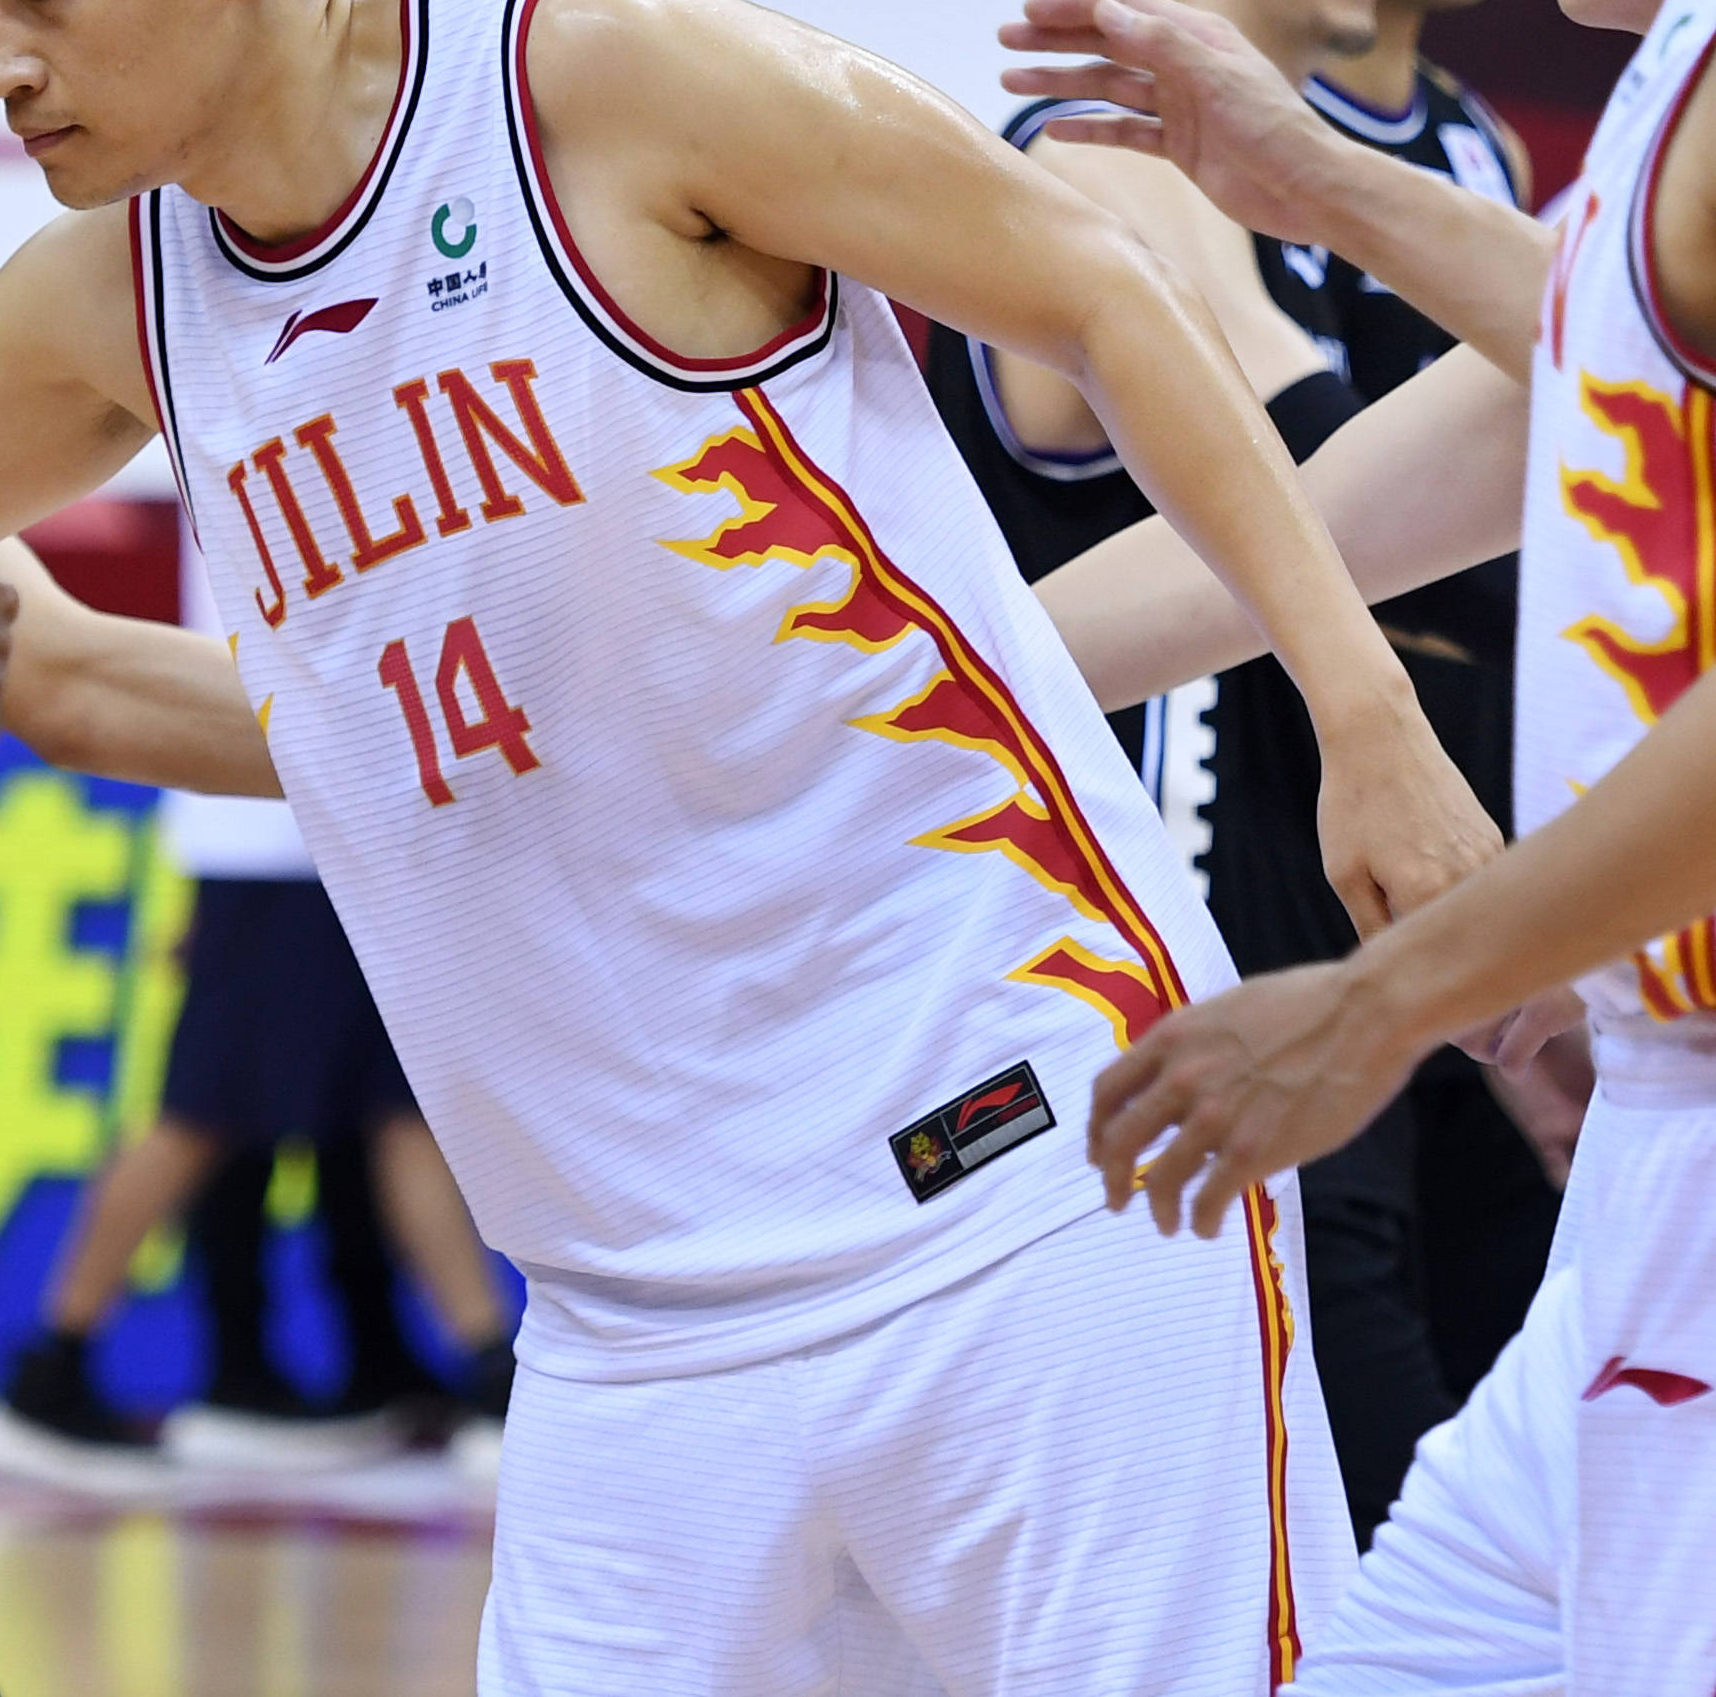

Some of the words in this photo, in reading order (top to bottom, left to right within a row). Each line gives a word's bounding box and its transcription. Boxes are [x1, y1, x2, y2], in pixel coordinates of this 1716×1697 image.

[431, 292, 469, 312] CHINA
[227, 358, 587, 630] JILIN
[377, 615, 541, 806] 14
